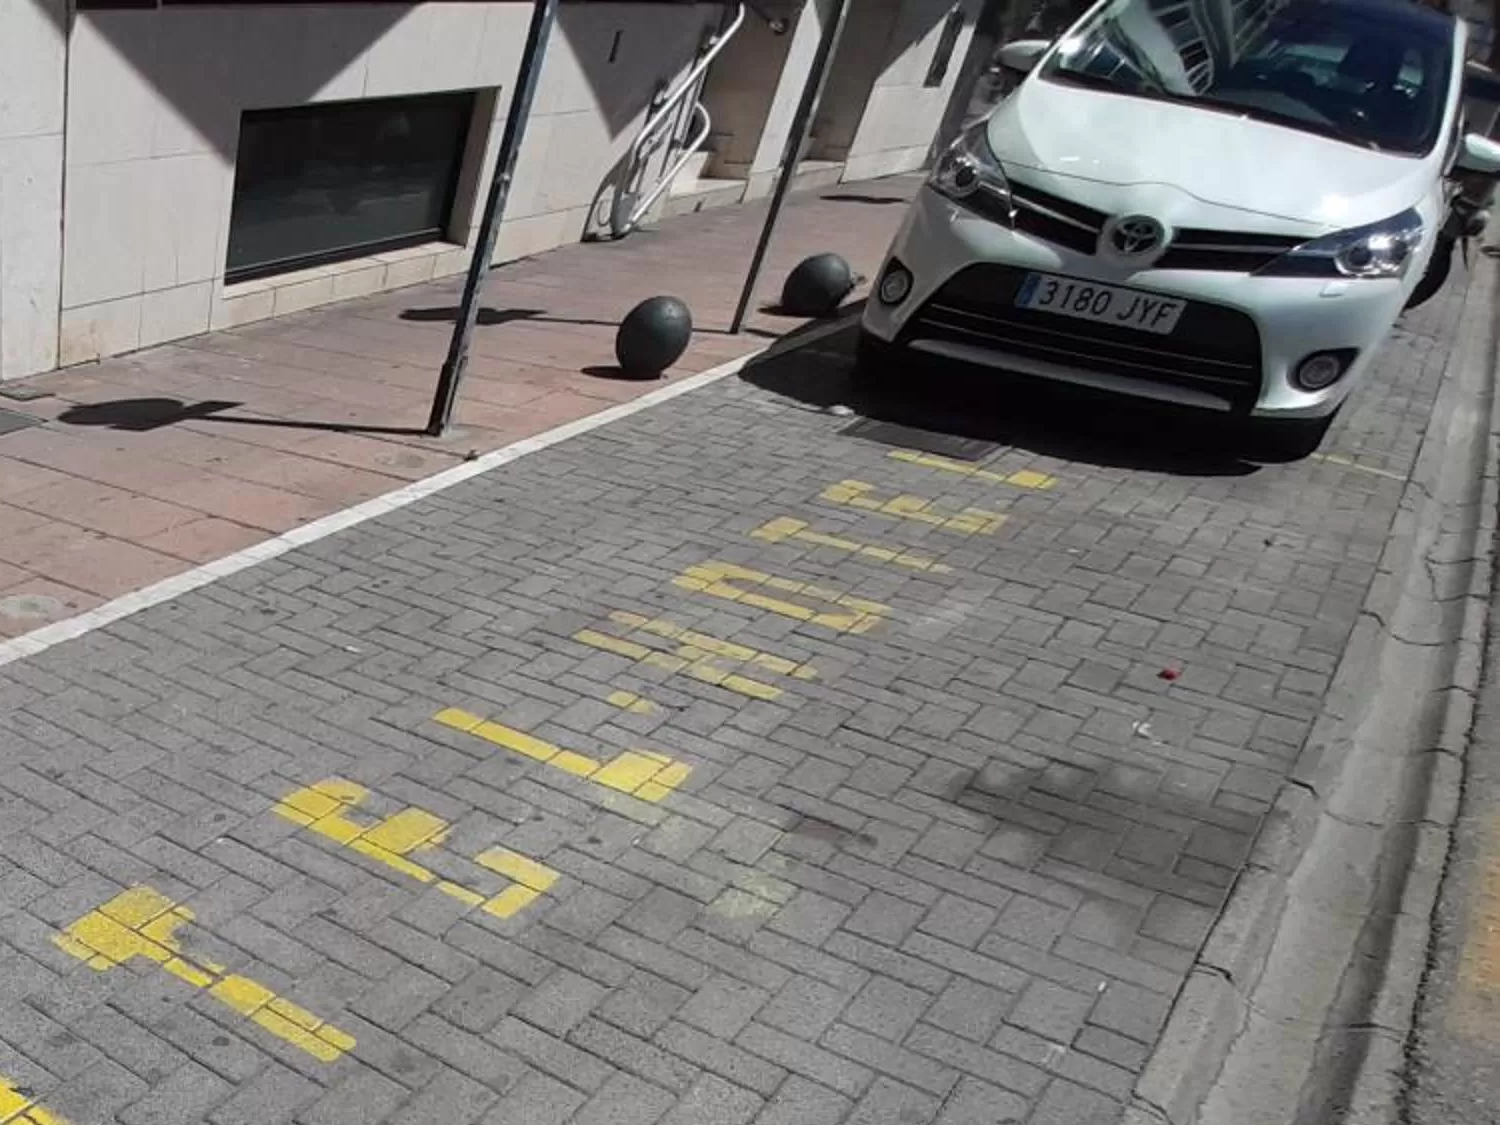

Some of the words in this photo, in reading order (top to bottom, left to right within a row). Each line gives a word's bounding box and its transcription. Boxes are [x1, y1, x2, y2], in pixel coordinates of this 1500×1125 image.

[1039, 281, 1113, 316] 3180
[1116, 297, 1178, 328] JYF
[571, 449, 1058, 700] HOTEL
